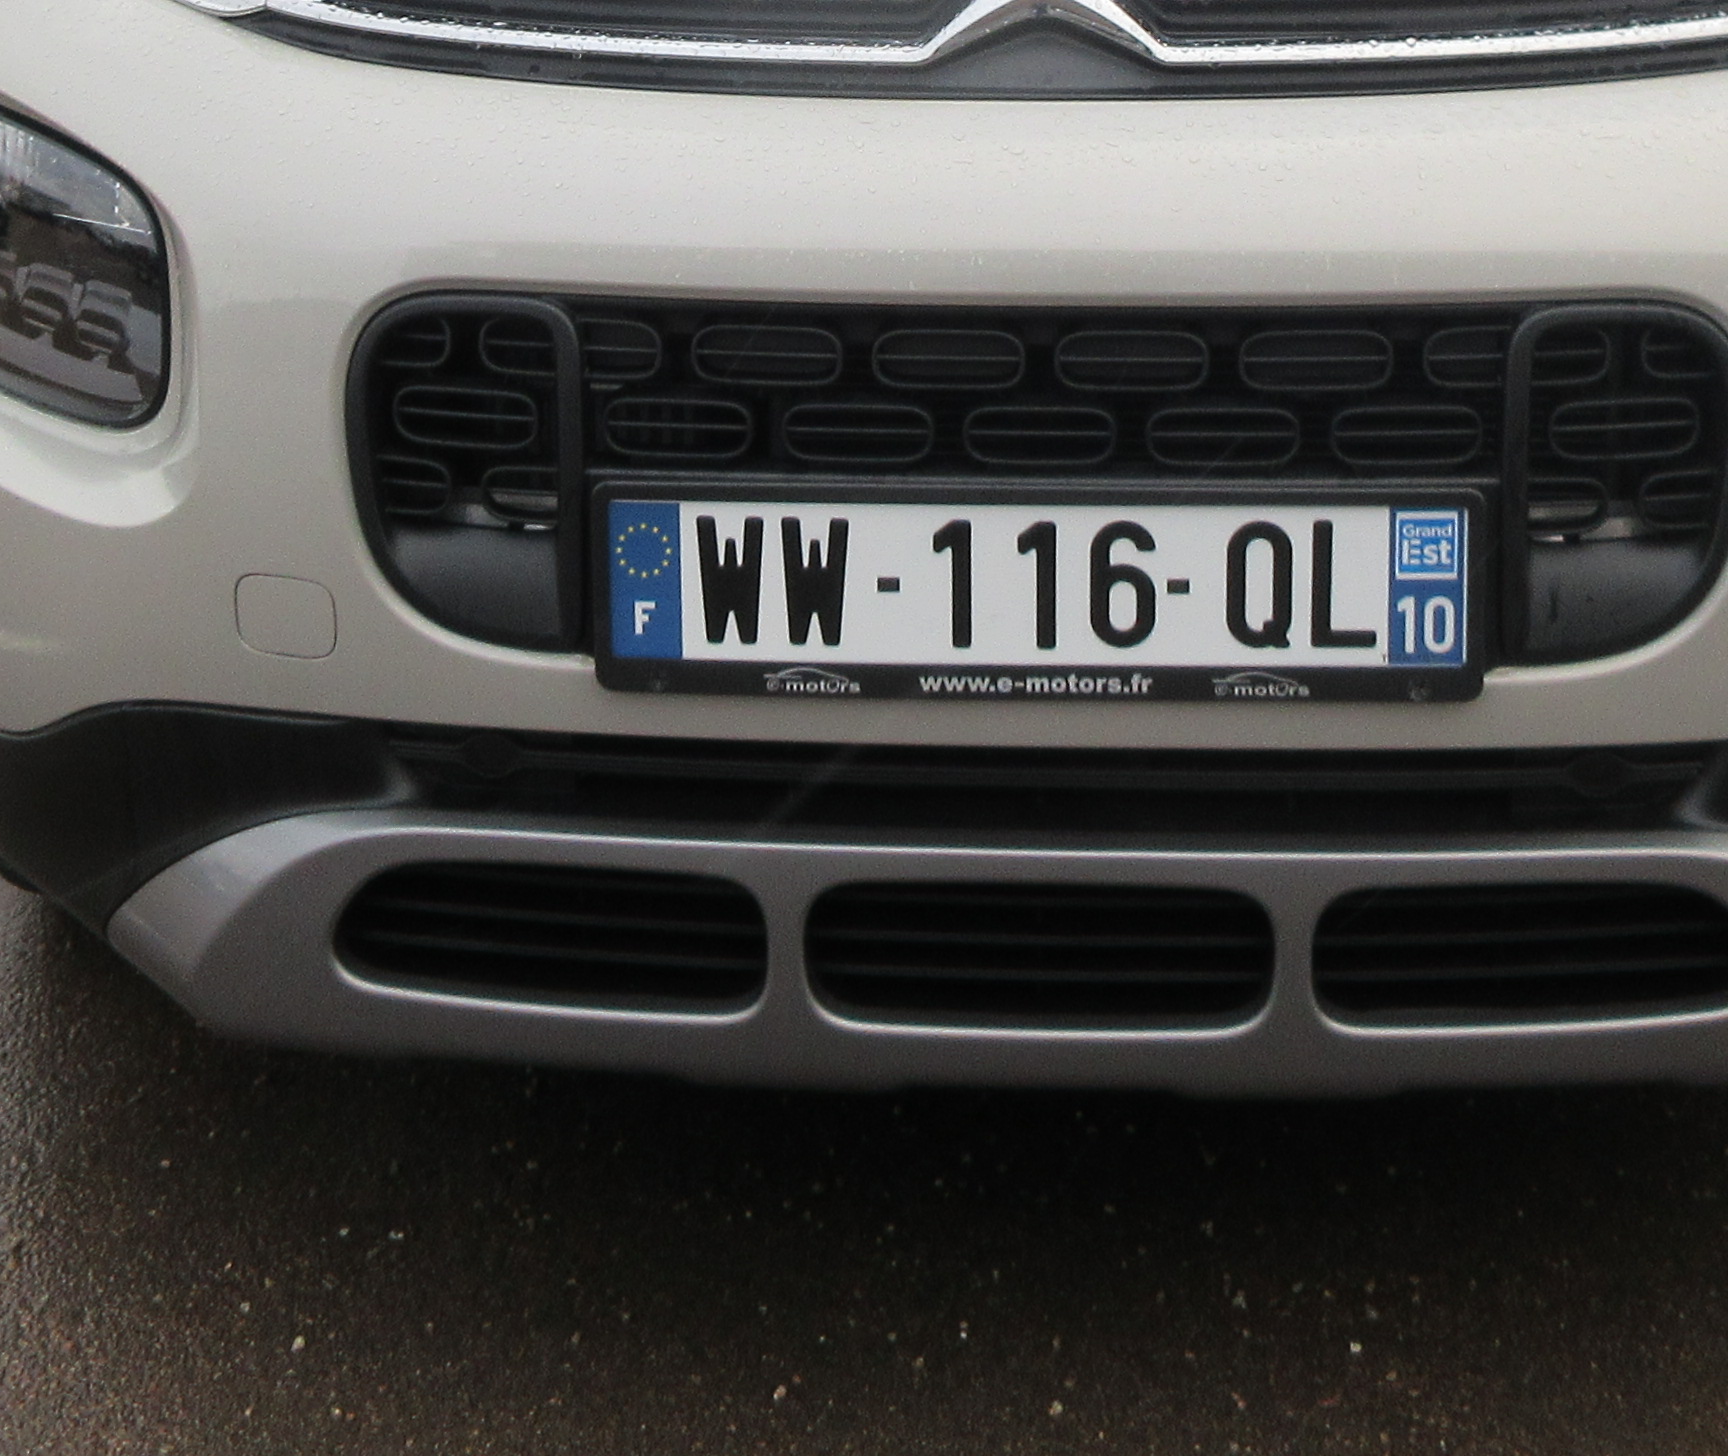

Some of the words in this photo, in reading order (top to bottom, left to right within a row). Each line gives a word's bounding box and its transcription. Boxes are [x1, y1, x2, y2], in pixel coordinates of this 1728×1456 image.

[1402, 524, 1453, 538] Grand
[1402, 540, 1453, 566] Est
[696, 515, 1377, 649] WW-116-QL
[633, 600, 657, 635] F
[1397, 596, 1455, 654] 10
[919, 673, 1152, 694] www.e-motors.fr
